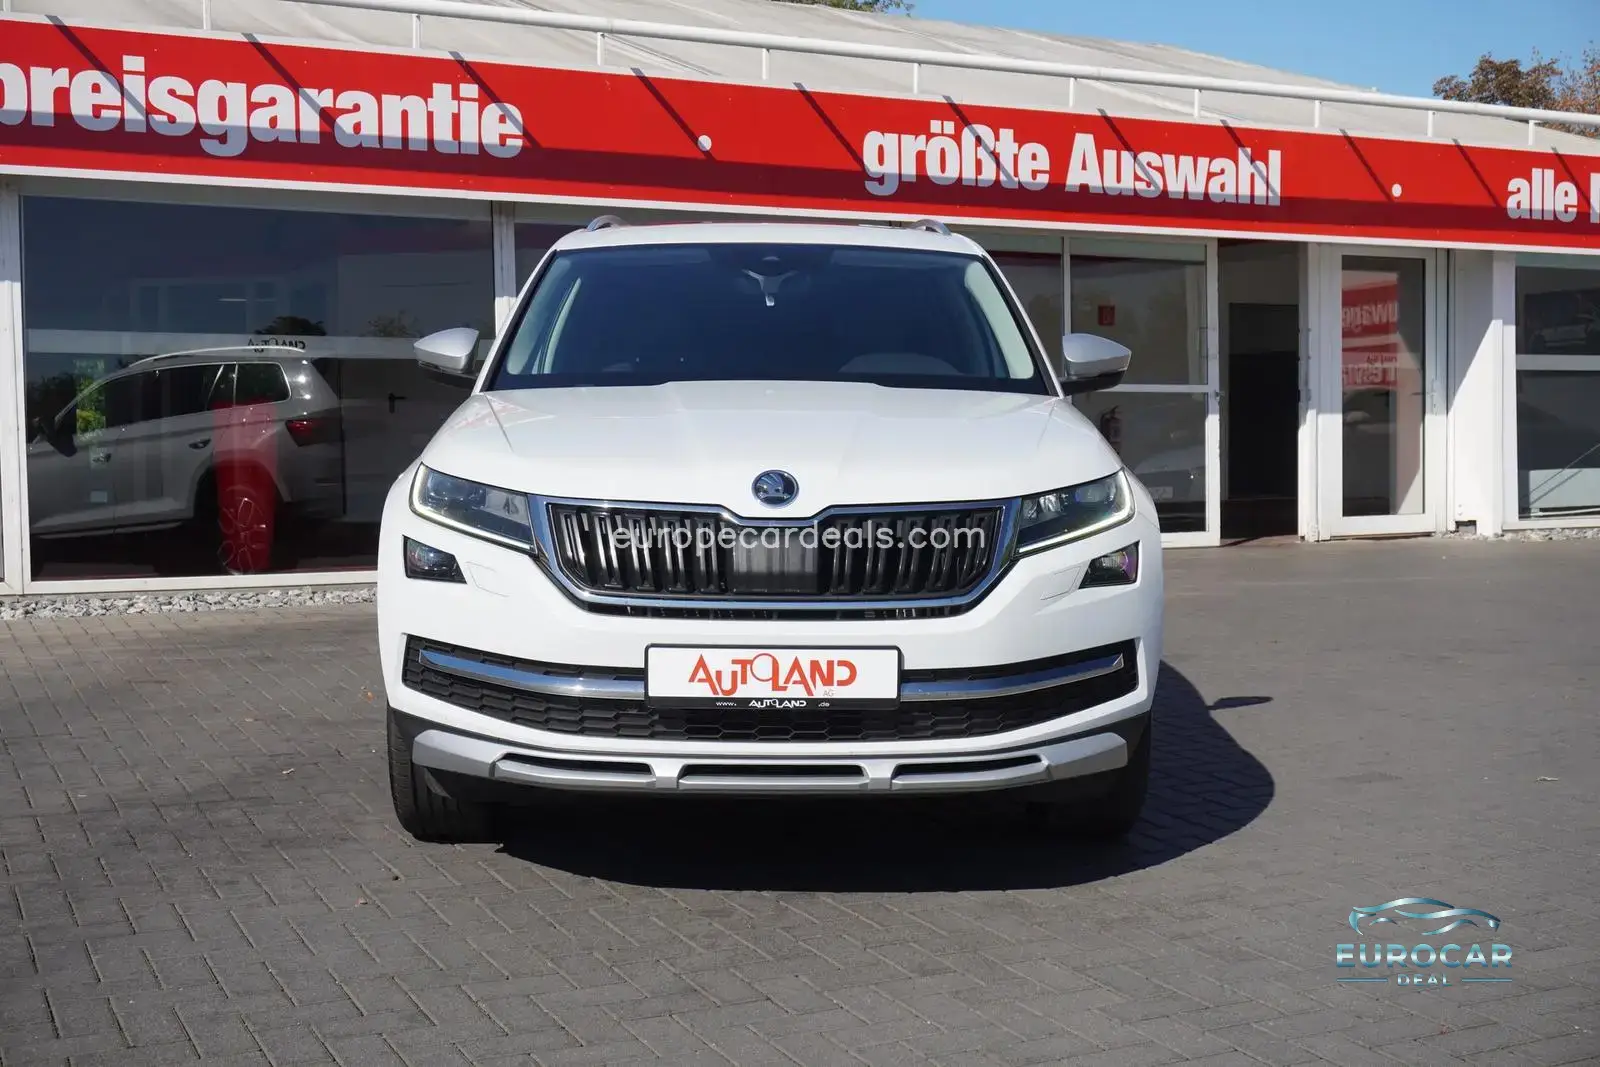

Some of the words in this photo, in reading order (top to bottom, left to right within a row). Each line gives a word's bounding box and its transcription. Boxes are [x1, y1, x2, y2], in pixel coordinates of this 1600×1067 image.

[863, 119, 1050, 196] größte
[1065, 132, 1281, 206] Auswahl
[1506, 167, 1578, 223] alle
[688, 652, 858, 697] AUTOLAND
[748, 698, 807, 709] AUTOLAND
